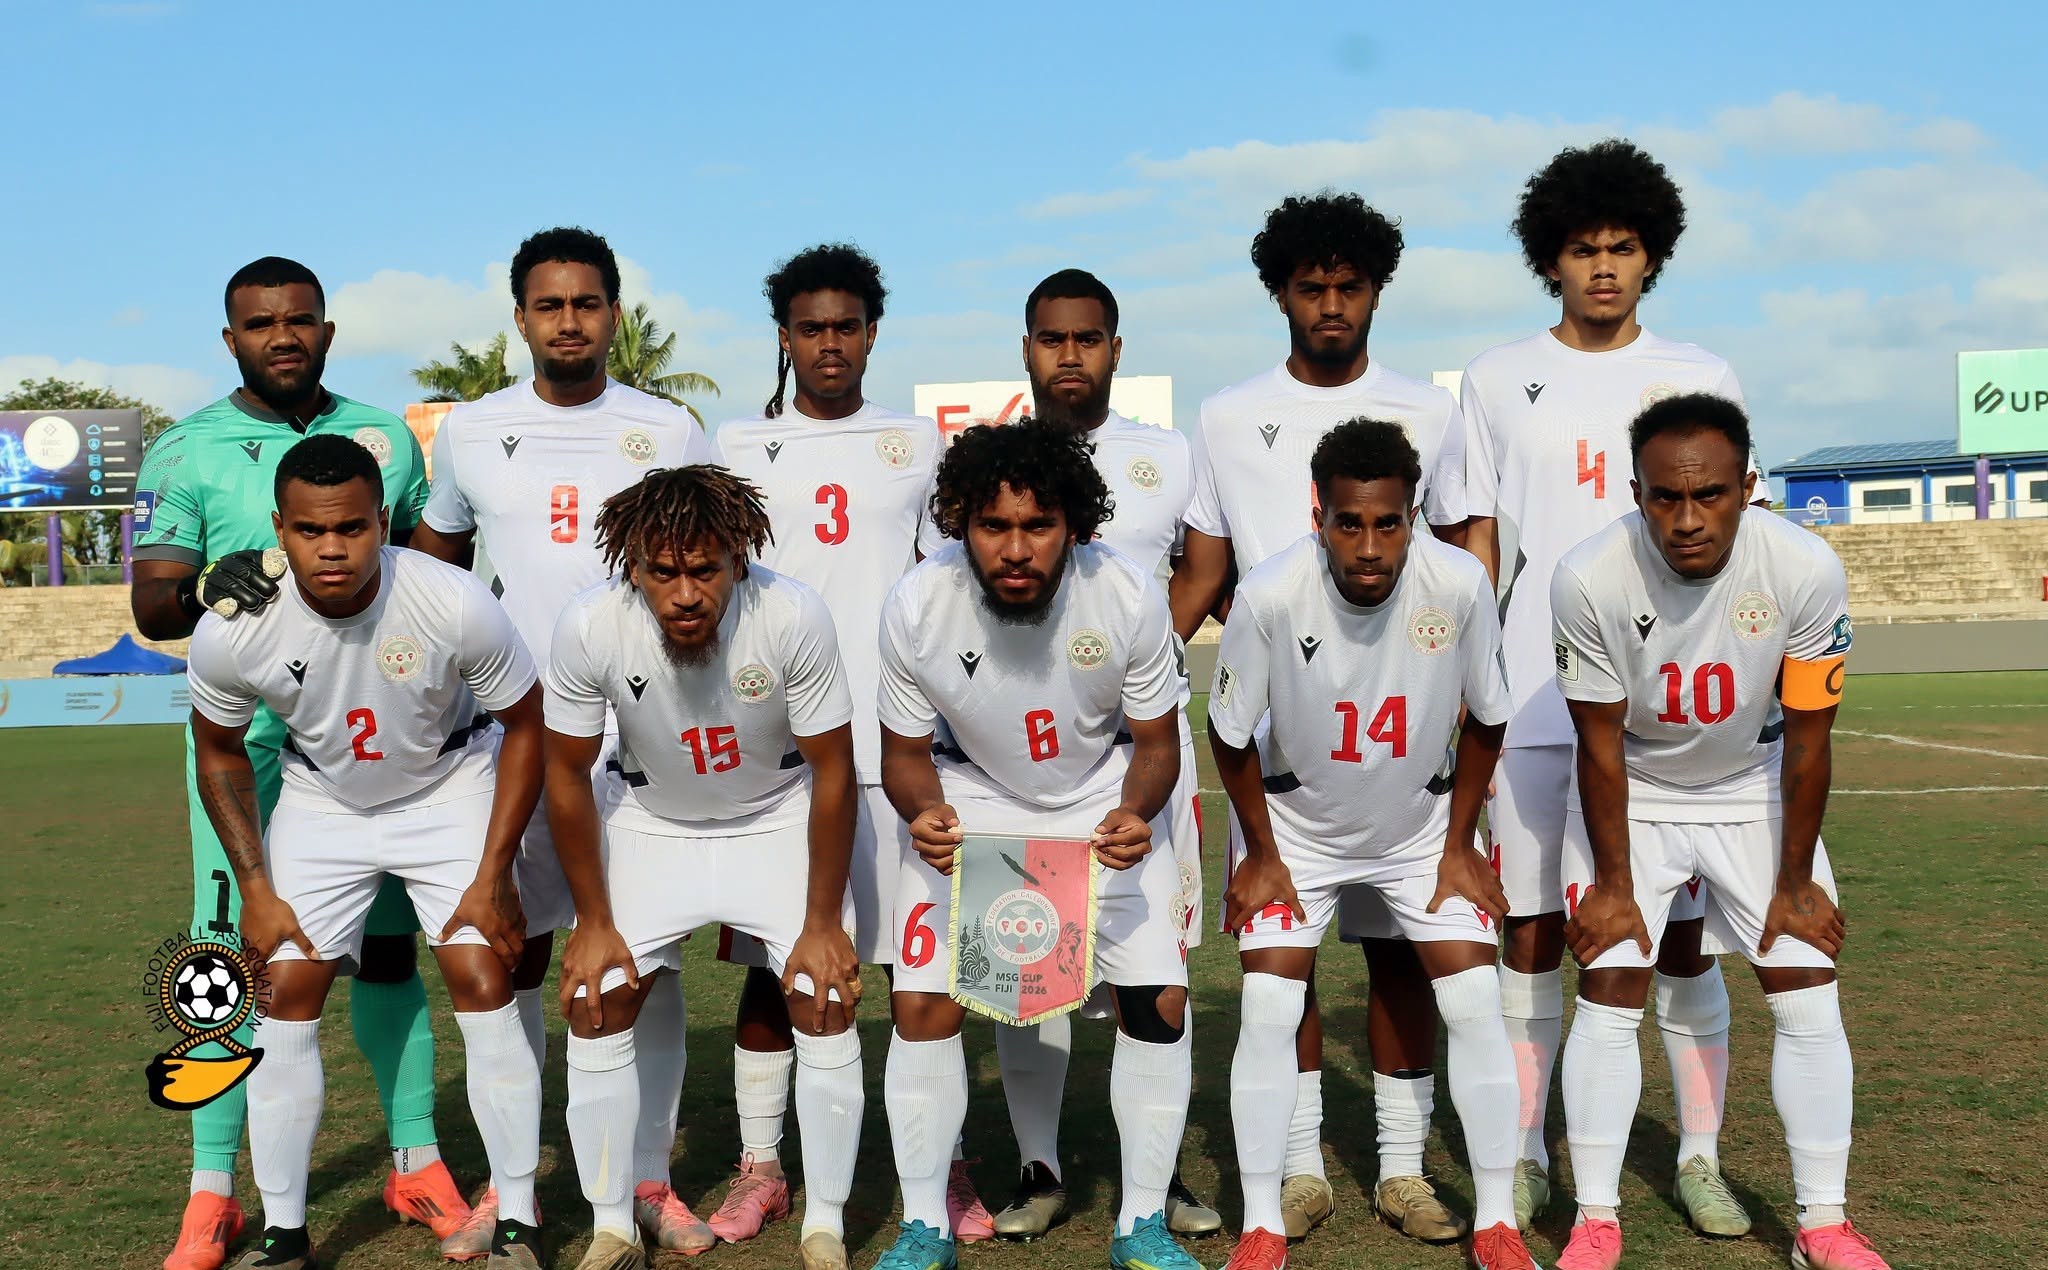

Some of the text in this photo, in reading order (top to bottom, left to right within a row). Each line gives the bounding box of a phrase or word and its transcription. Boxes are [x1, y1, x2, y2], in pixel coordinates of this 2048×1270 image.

[1577, 440, 1605, 499] 4
[551, 485, 579, 544] 9
[814, 484, 850, 546] 3
[1658, 662, 1736, 725] 10
[346, 708, 384, 761] 2
[680, 725, 741, 774] 15
[1025, 709, 1059, 763] 6
[1331, 696, 1407, 763] 14
[208, 869, 234, 933] 1
[902, 902, 937, 969] 6
[995, 972, 1043, 983] MSG CUP
[995, 983, 1047, 995] FIJI 2026
